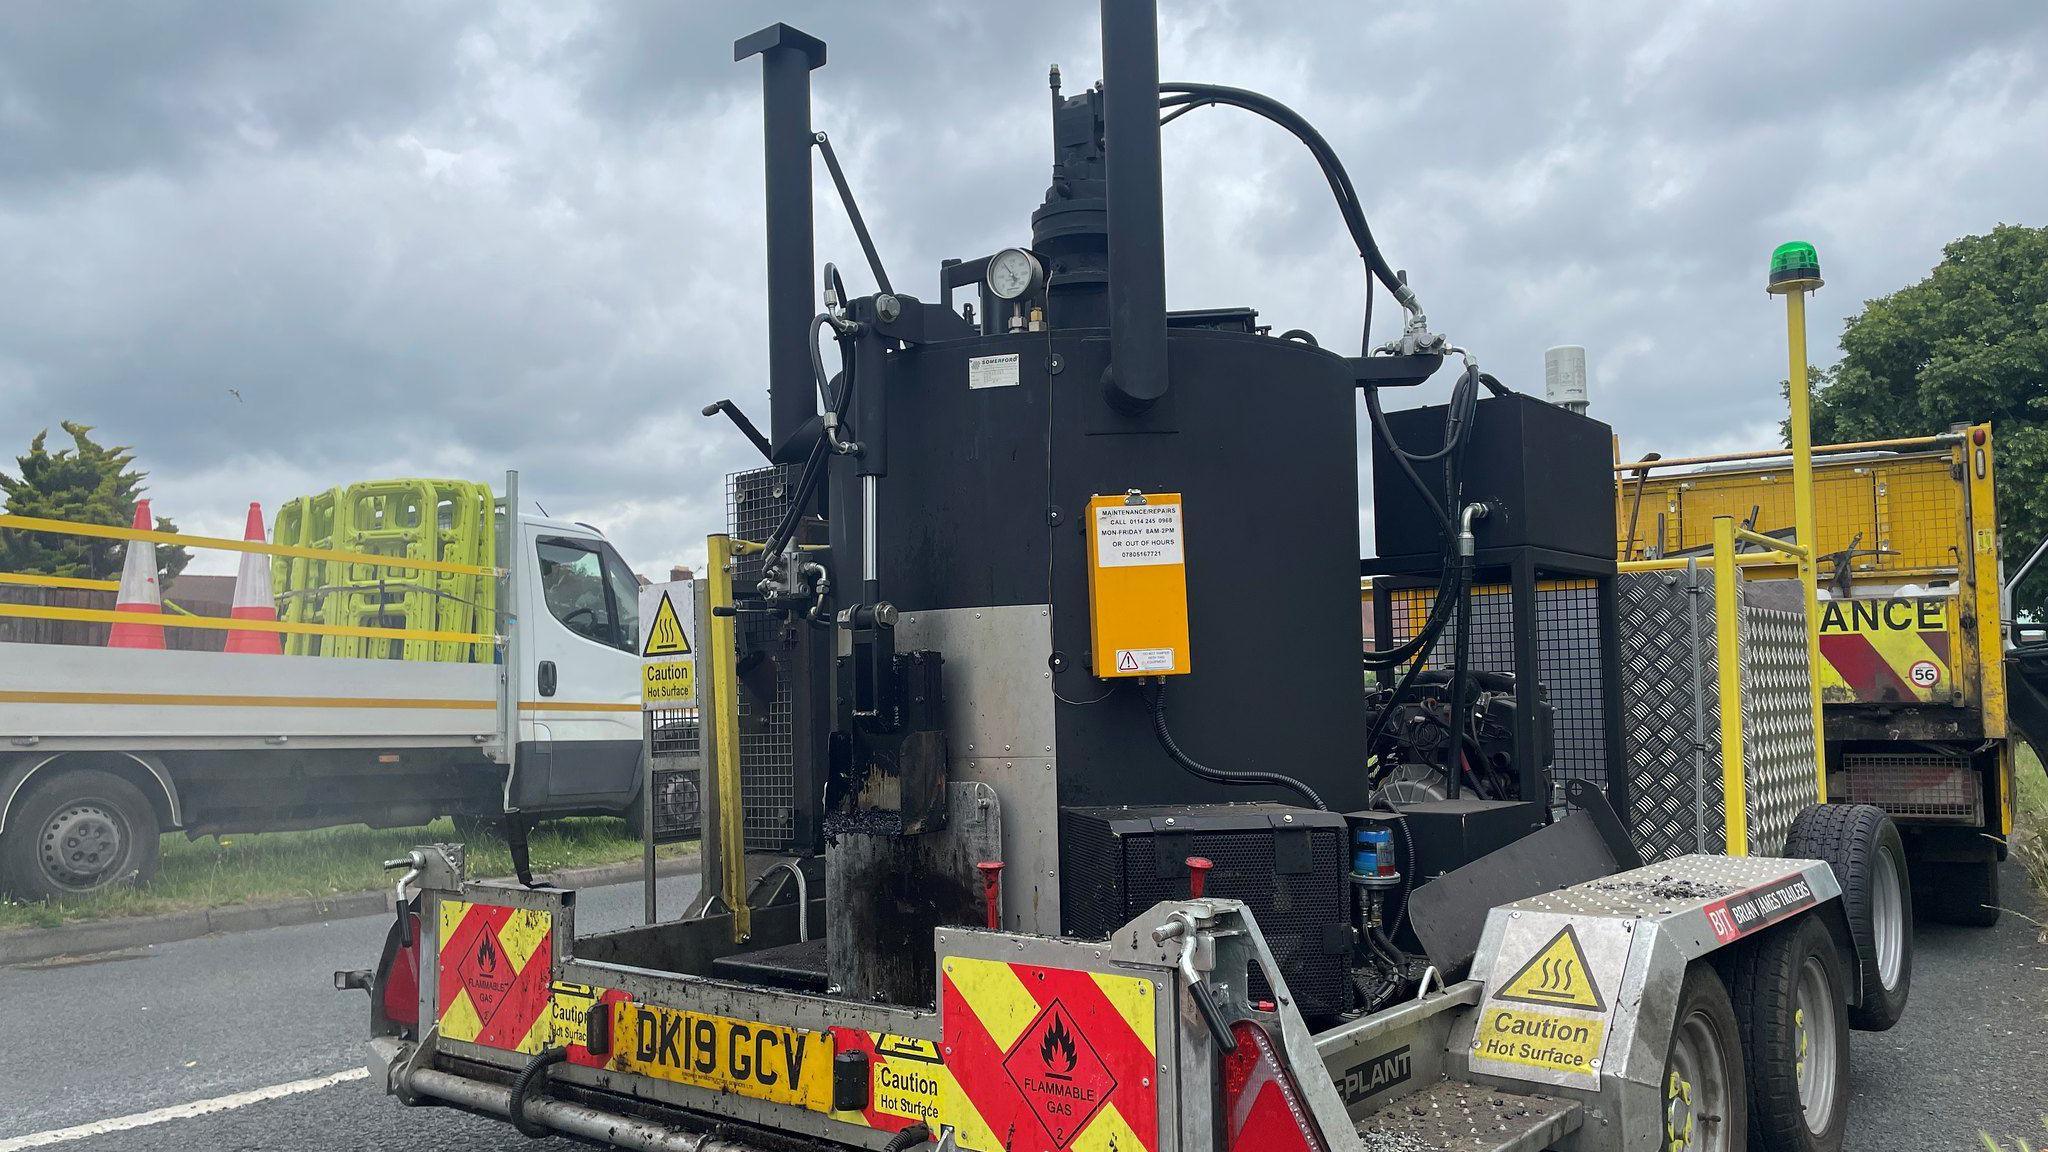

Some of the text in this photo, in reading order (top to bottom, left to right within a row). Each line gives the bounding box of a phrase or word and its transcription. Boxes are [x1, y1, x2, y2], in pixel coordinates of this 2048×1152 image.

[1102, 507, 1176, 515] MAINTENANCE/REPAIRS
[647, 664, 688, 681] Caution
[1915, 669, 1935, 681] 56
[647, 685, 689, 697] Hot Surface
[1731, 900, 1760, 924] BRIAN
[1756, 892, 1782, 917] JAMES
[1776, 881, 1811, 906] TRAILERS
[468, 978, 505, 992] FLAMMABLE
[480, 993, 493, 1004] GAS
[565, 1027, 587, 1042] Surfac
[1494, 1012, 1589, 1044] Caution
[636, 1009, 806, 1091] DK19 GCV
[1486, 1038, 1583, 1066] Hot Surface
[881, 1066, 938, 1096] Caution
[1024, 1078, 1095, 1102] FLAMMABLE
[881, 1094, 939, 1118] Hot Surface
[1046, 1100, 1072, 1116] GAS
[1056, 1128, 1063, 1140] 2
